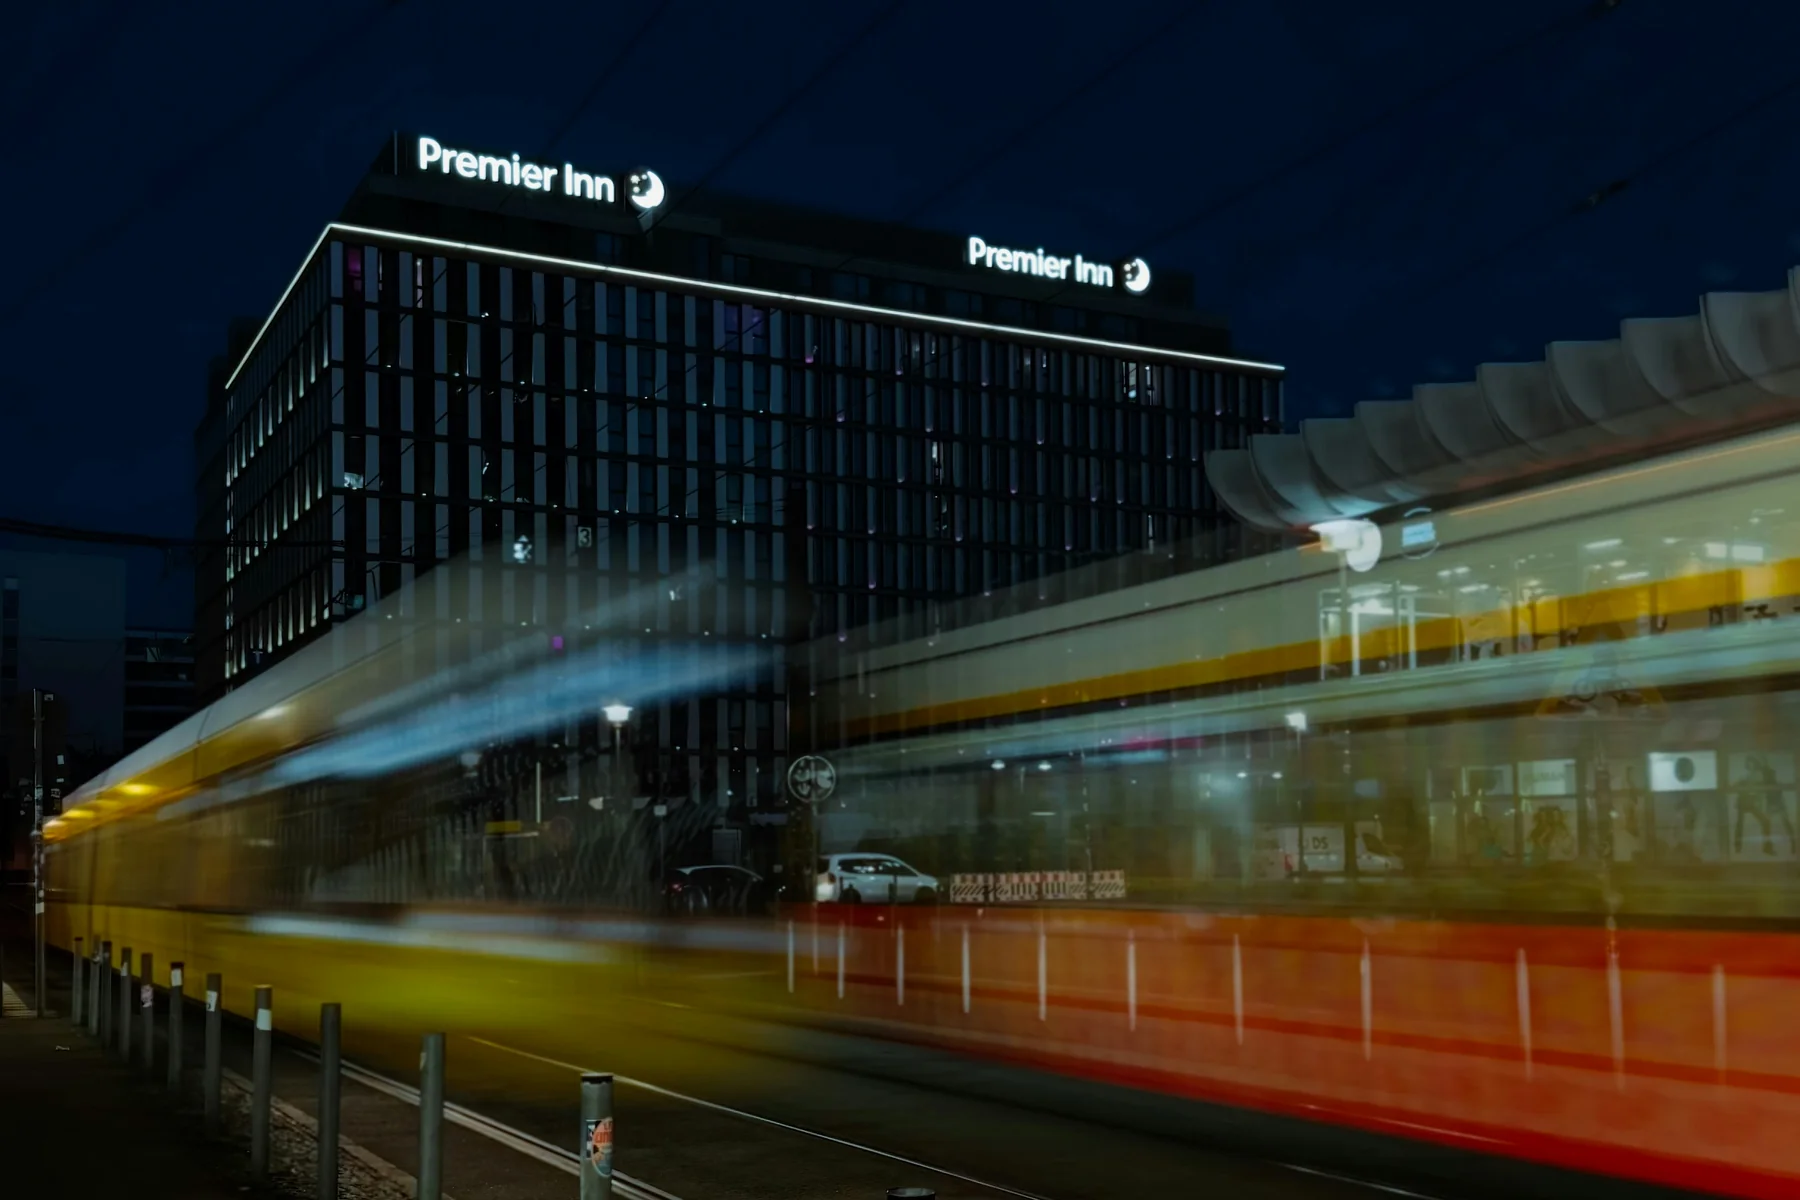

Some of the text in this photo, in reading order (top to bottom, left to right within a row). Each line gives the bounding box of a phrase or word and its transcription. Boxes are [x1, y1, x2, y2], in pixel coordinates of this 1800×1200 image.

[418, 135, 616, 203] Premier Inn
[968, 236, 1114, 288] Premier Inn
[579, 528, 590, 546] 3
